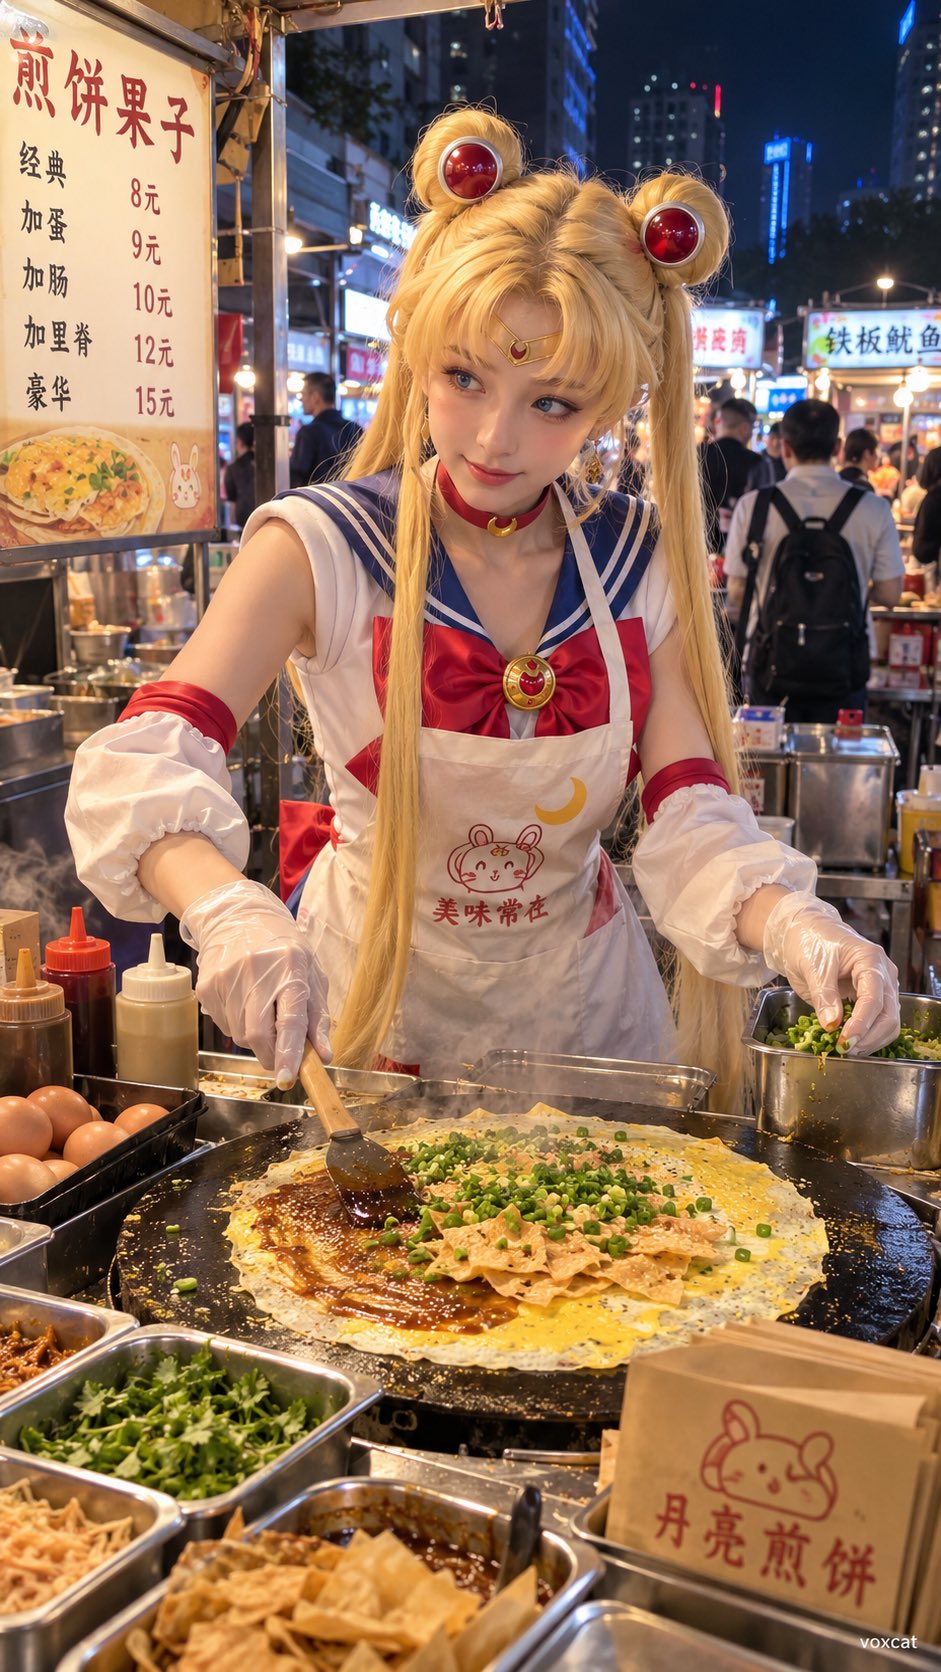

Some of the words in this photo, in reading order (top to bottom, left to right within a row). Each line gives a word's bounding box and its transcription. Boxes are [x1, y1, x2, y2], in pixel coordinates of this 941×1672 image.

[10, 27, 195, 164] 煎饼果子
[19, 141, 66, 189] 经典
[131, 178, 161, 216] 8元
[21, 200, 68, 244] 加蛋
[132, 230, 162, 266] 9元
[23, 257, 69, 299] 加肠
[133, 282, 173, 318] 10元
[24, 315, 93, 358] 加里脊
[134, 334, 174, 368] 12元
[825, 323, 941, 356] 铁板鱿鱼
[26, 372, 72, 412] 豪华
[136, 386, 175, 418] 15元
[432, 894, 549, 928] 美味常在
[655, 1492, 876, 1608] 丹亮煎饼
